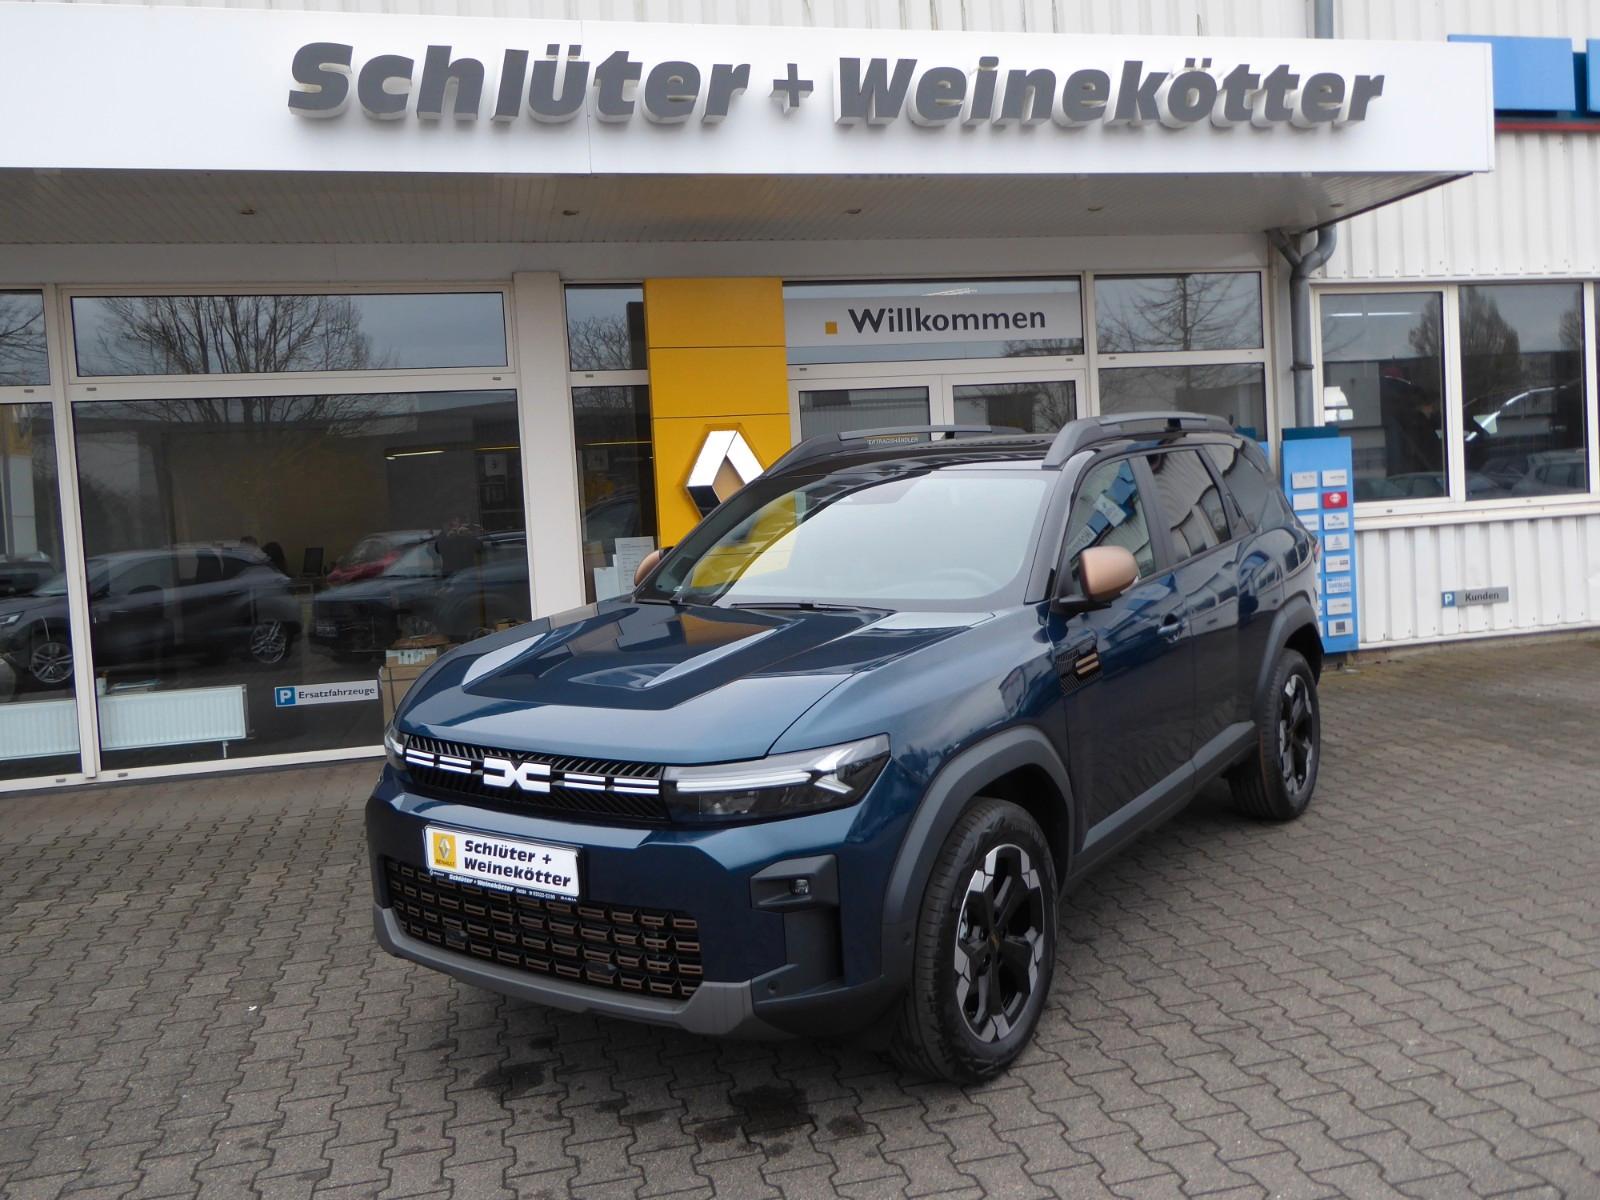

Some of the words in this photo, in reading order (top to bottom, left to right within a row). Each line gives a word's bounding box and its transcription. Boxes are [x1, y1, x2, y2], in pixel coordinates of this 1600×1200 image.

[288, 42, 751, 124] Schlüter
[768, 62, 814, 114] +
[835, 56, 1385, 127] Weinekötter
[848, 307, 1046, 333] Willkommen
[1444, 593, 1453, 604] P
[1465, 591, 1499, 602] Kunden
[280, 689, 292, 703] P
[298, 687, 375, 699] Ersatzfahrzeuge
[464, 840, 536, 863] Schlüter
[464, 857, 571, 887] Weinekötter
